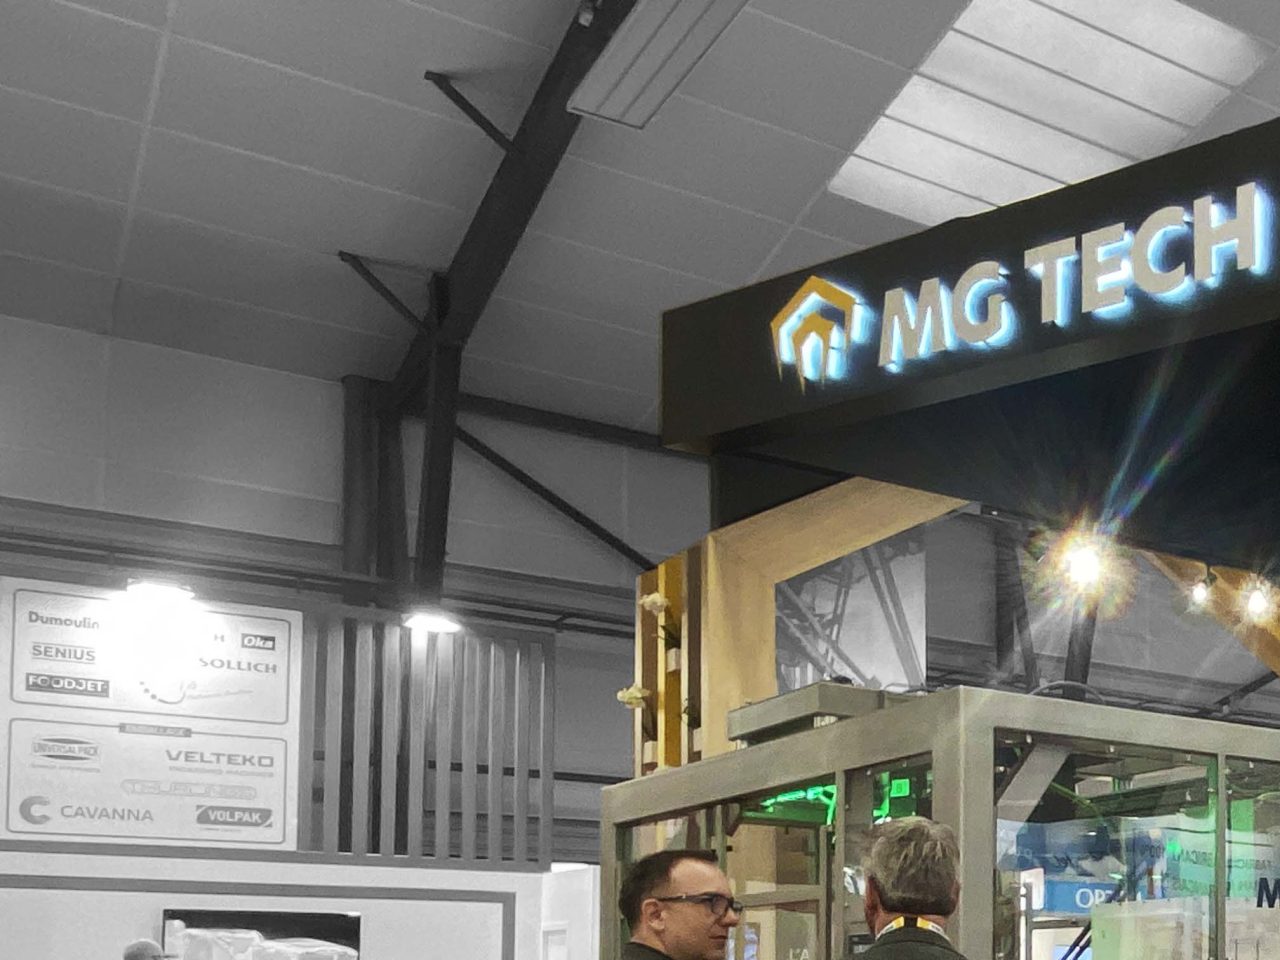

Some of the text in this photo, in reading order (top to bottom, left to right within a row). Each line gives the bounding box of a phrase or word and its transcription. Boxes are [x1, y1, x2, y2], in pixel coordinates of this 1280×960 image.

[878, 181, 1257, 367] MG TECH
[28, 610, 99, 629] Dumoulin
[32, 644, 96, 661] SENIUS
[199, 658, 277, 674] SOLLICH
[166, 750, 274, 767] VELTEKO
[61, 805, 154, 821] CAVANNA
[208, 811, 262, 823] VOLPAK
